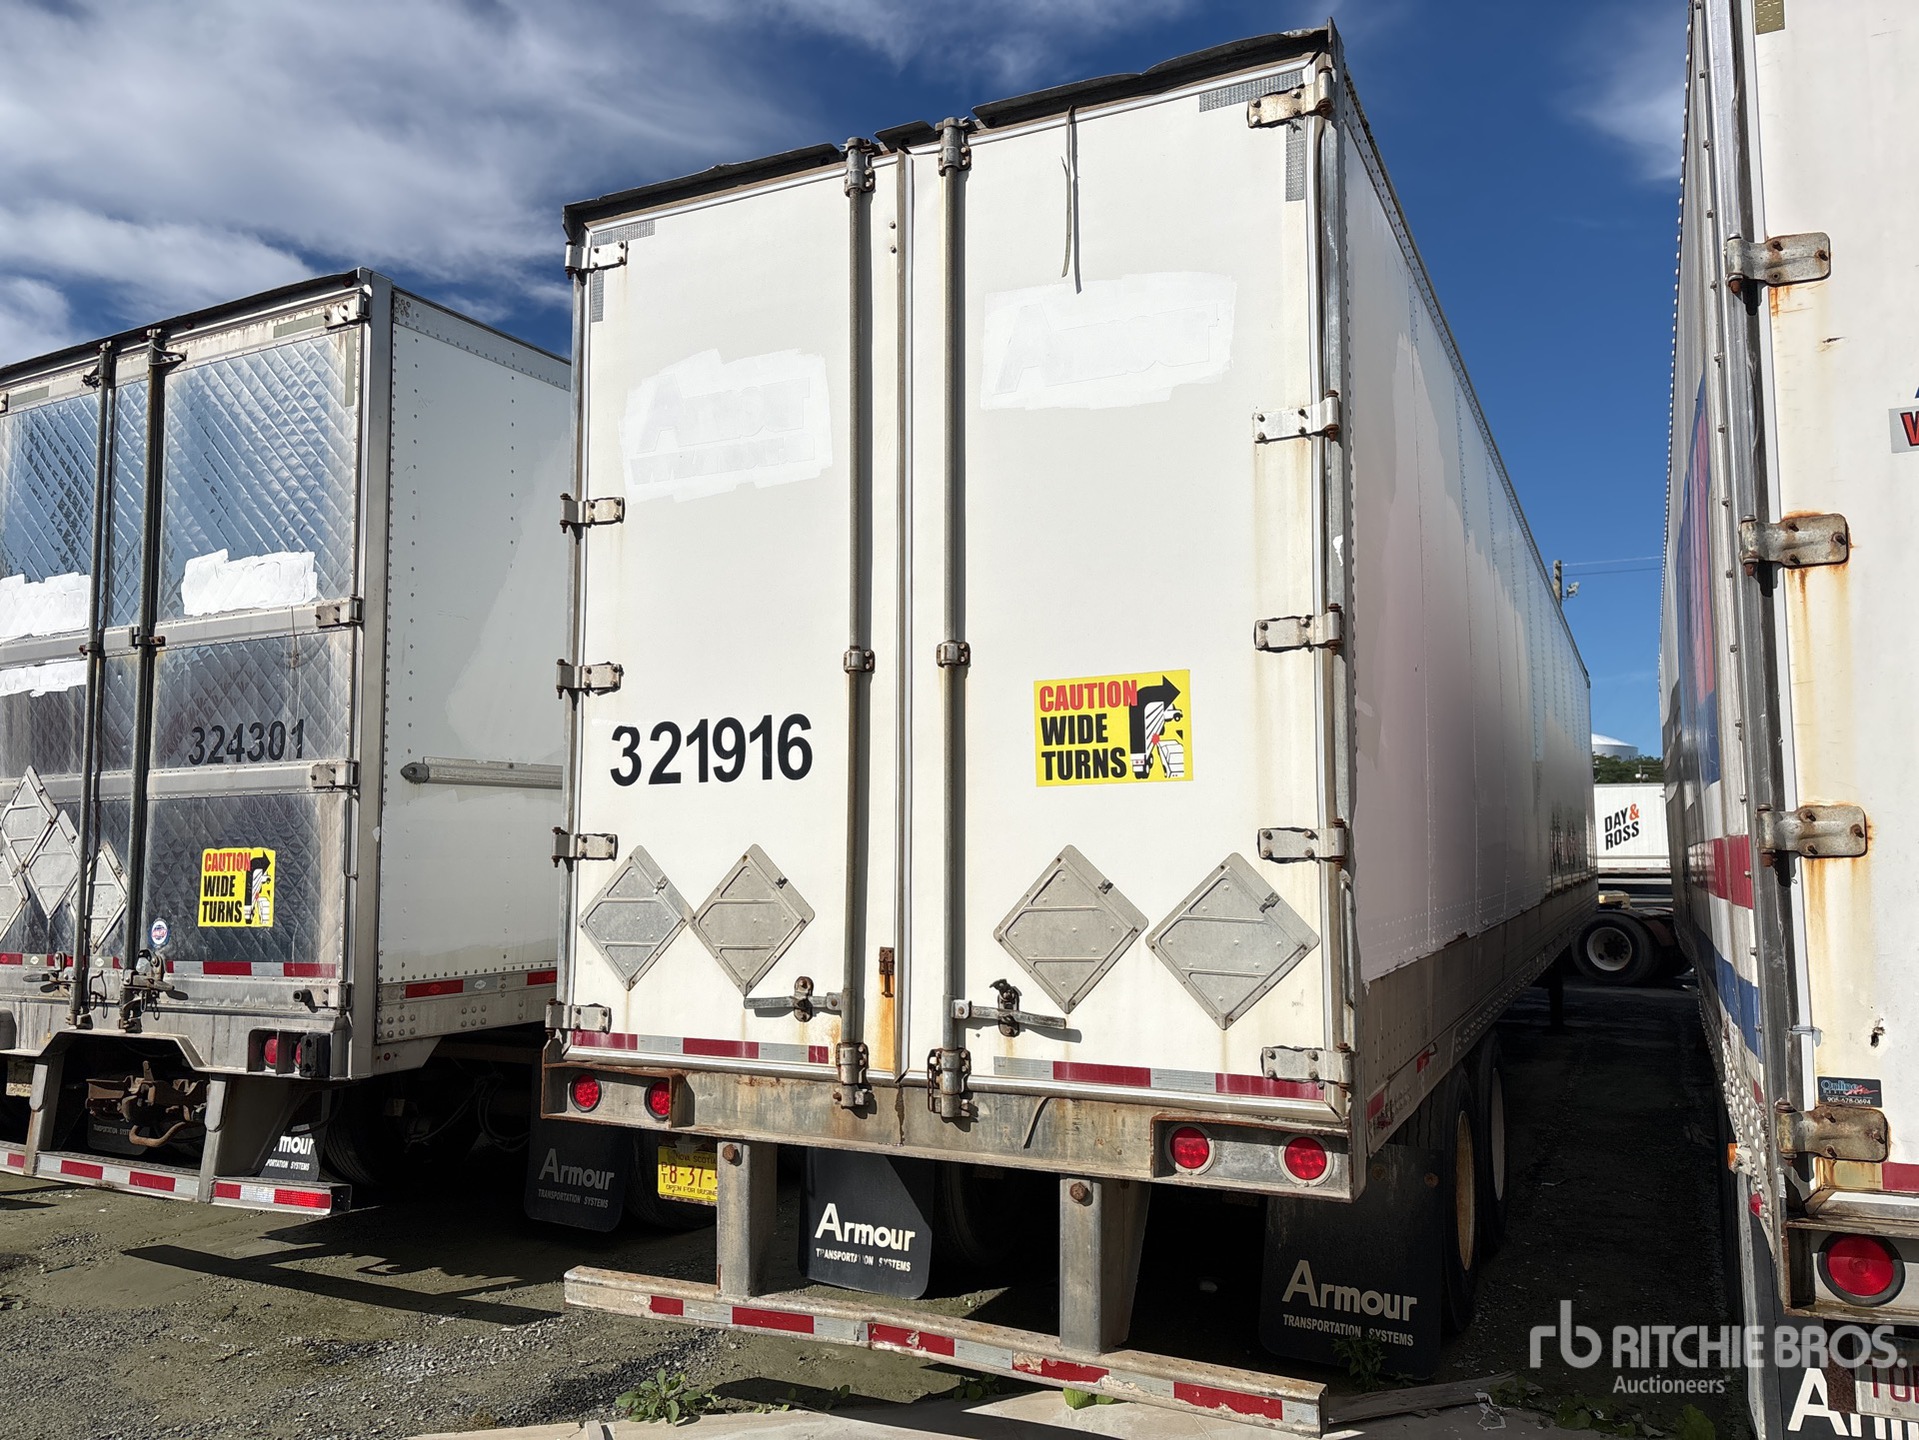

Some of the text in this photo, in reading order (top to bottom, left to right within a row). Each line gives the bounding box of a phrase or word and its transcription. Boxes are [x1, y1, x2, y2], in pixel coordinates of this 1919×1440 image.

[1039, 680, 1138, 712] CAUTION
[188, 718, 304, 765] 324301
[1041, 713, 1109, 746] WIDE
[610, 713, 813, 786] 321916
[1041, 747, 1127, 780] TURNS
[1605, 821, 1640, 850] ROSS
[204, 852, 252, 872] CAUTION
[203, 875, 236, 897] WIDE
[202, 900, 242, 923] TURNS
[538, 1147, 614, 1191] Armour
[538, 1188, 609, 1209] TRANSPORTATION SYSTEMS
[814, 1202, 916, 1252] Armour
[1281, 1259, 1418, 1322] Armour
[1282, 1314, 1414, 1347] TRANSPORTATION SYSTEMS
